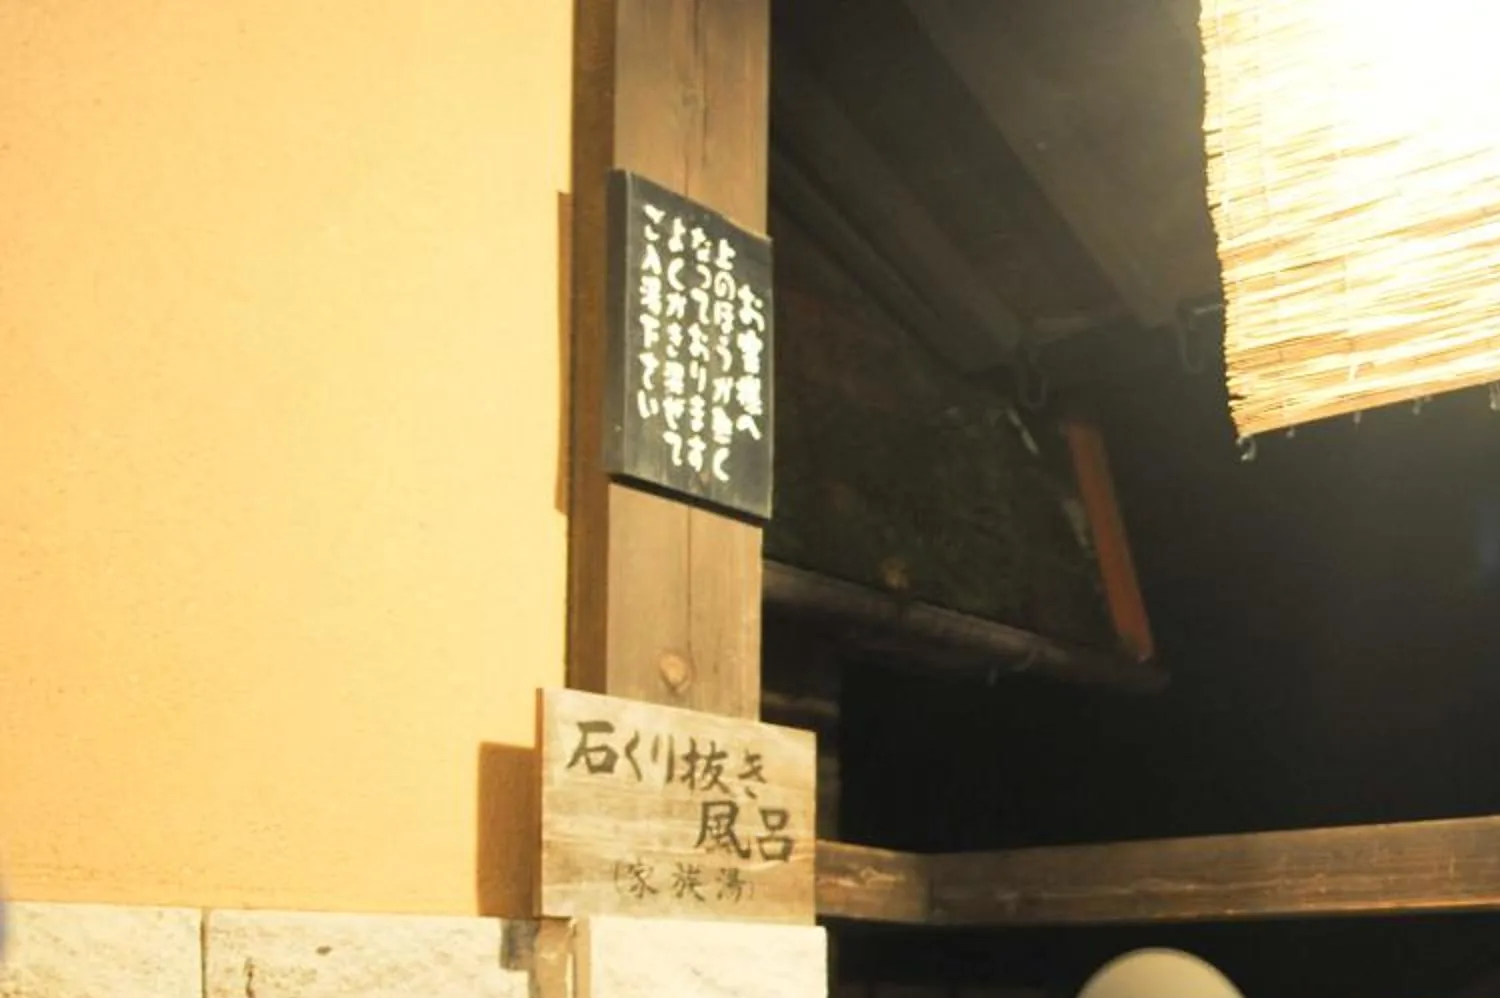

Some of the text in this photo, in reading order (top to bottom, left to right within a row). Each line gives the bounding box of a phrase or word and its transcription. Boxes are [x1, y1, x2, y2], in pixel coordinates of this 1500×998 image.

[687, 227, 713, 472] なっております
[566, 720, 767, 800] 石くり抜き
[693, 800, 794, 862] 風呂
